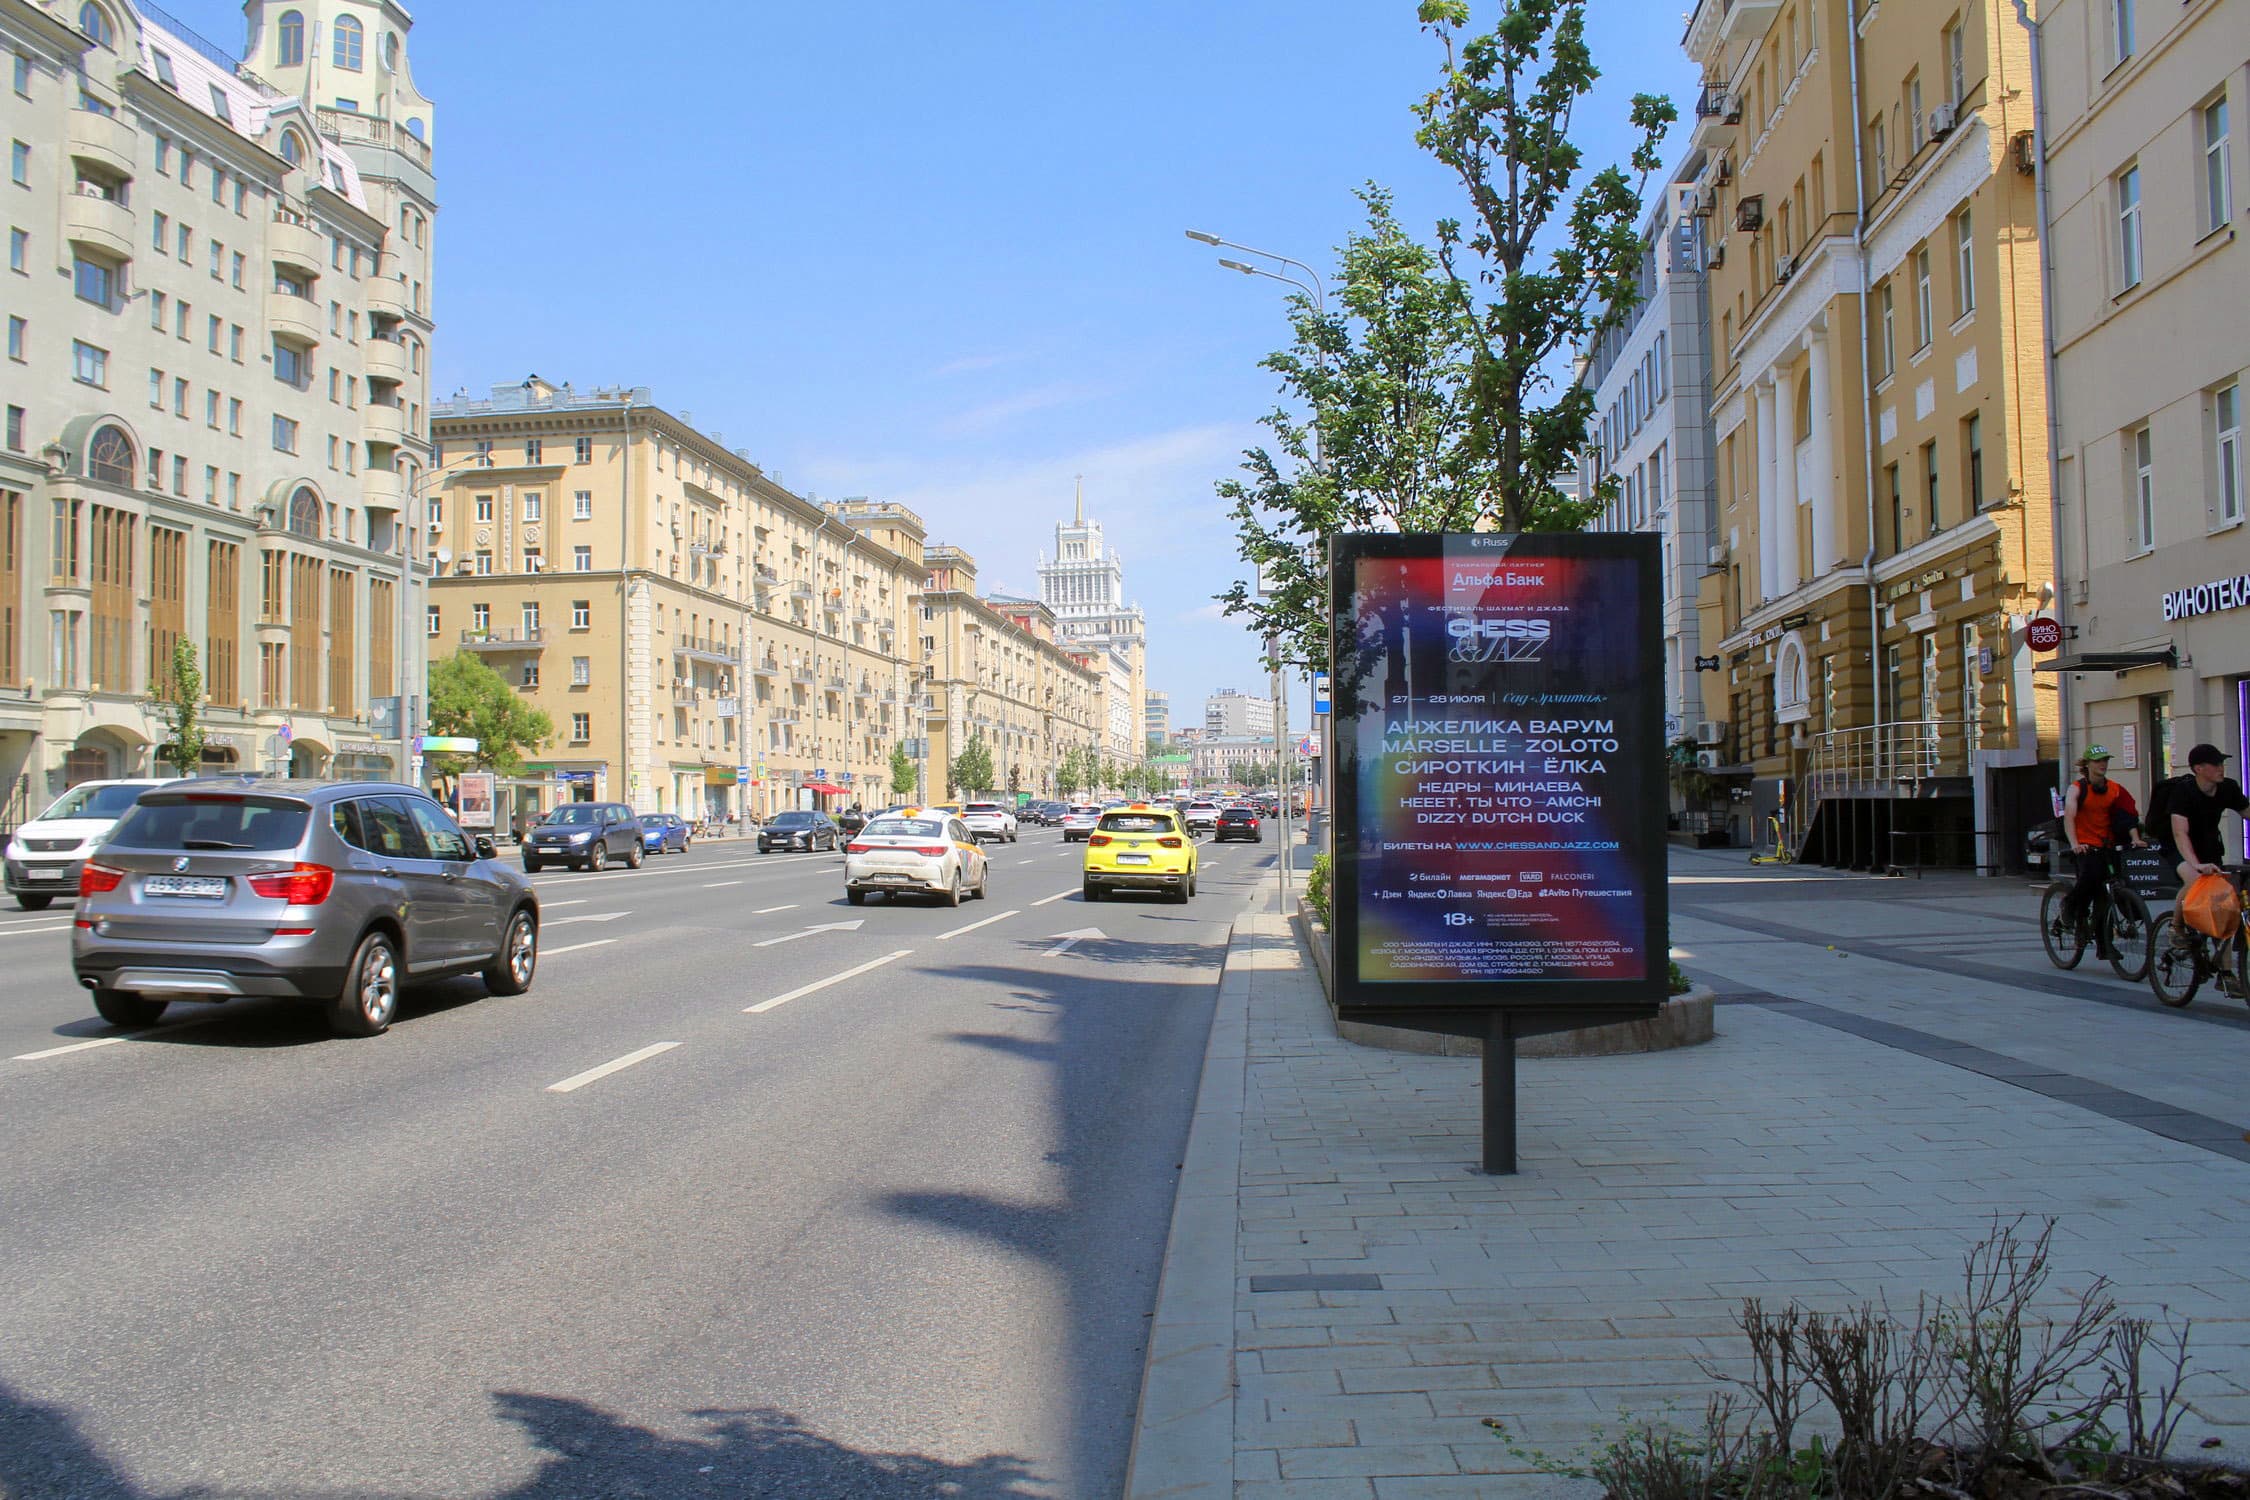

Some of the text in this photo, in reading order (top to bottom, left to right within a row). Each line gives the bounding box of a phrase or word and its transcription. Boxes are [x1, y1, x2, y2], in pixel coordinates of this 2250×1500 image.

[1483, 538, 1508, 546] Russ
[1452, 572, 1544, 589] Альфа Банк
[2162, 574, 2250, 622] ВИНОТЕКА
[1448, 619, 1550, 638] CHESS
[2032, 624, 2056, 634] ВИНО
[2032, 634, 2058, 644] FOOD
[1392, 695, 1408, 704] 27
[1429, 695, 1448, 704] 28
[1450, 695, 1485, 704] ИЮЛЯ
[1503, 692, 1528, 706] Сад
[1386, 720, 1613, 734] АНЖЕЛИКА ВАРУМ
[1382, 740, 1507, 754] MARSELLE
[1526, 738, 1619, 753] ZOLOTO
[1394, 760, 1526, 774] СИРОТКИН
[1544, 757, 1606, 774] ЁЛКА
[1418, 782, 1480, 794] НЕДРЫ
[1495, 782, 1583, 792] МИНАЕВА
[1400, 798, 1462, 809] НЕЕЕТ,
[1466, 798, 1492, 808] ТЫ
[1496, 797, 1532, 807] ЧТО
[1546, 796, 1602, 807] AMCHI
[1417, 812, 1584, 824] DIZZY DUTCH DUCK
[1384, 842, 1619, 850] БИЛЕТЫ НА WWW.CHESSANDJAZZ.COM
[1420, 872, 1451, 880] билайн
[1382, 890, 1402, 899] Дзен
[1408, 890, 1472, 898] Яндекс Лавка
[1476, 890, 1532, 898] Яндекс Еда
[1548, 888, 1632, 898] Avito Путешествия
[1443, 912, 1474, 926] 18+
